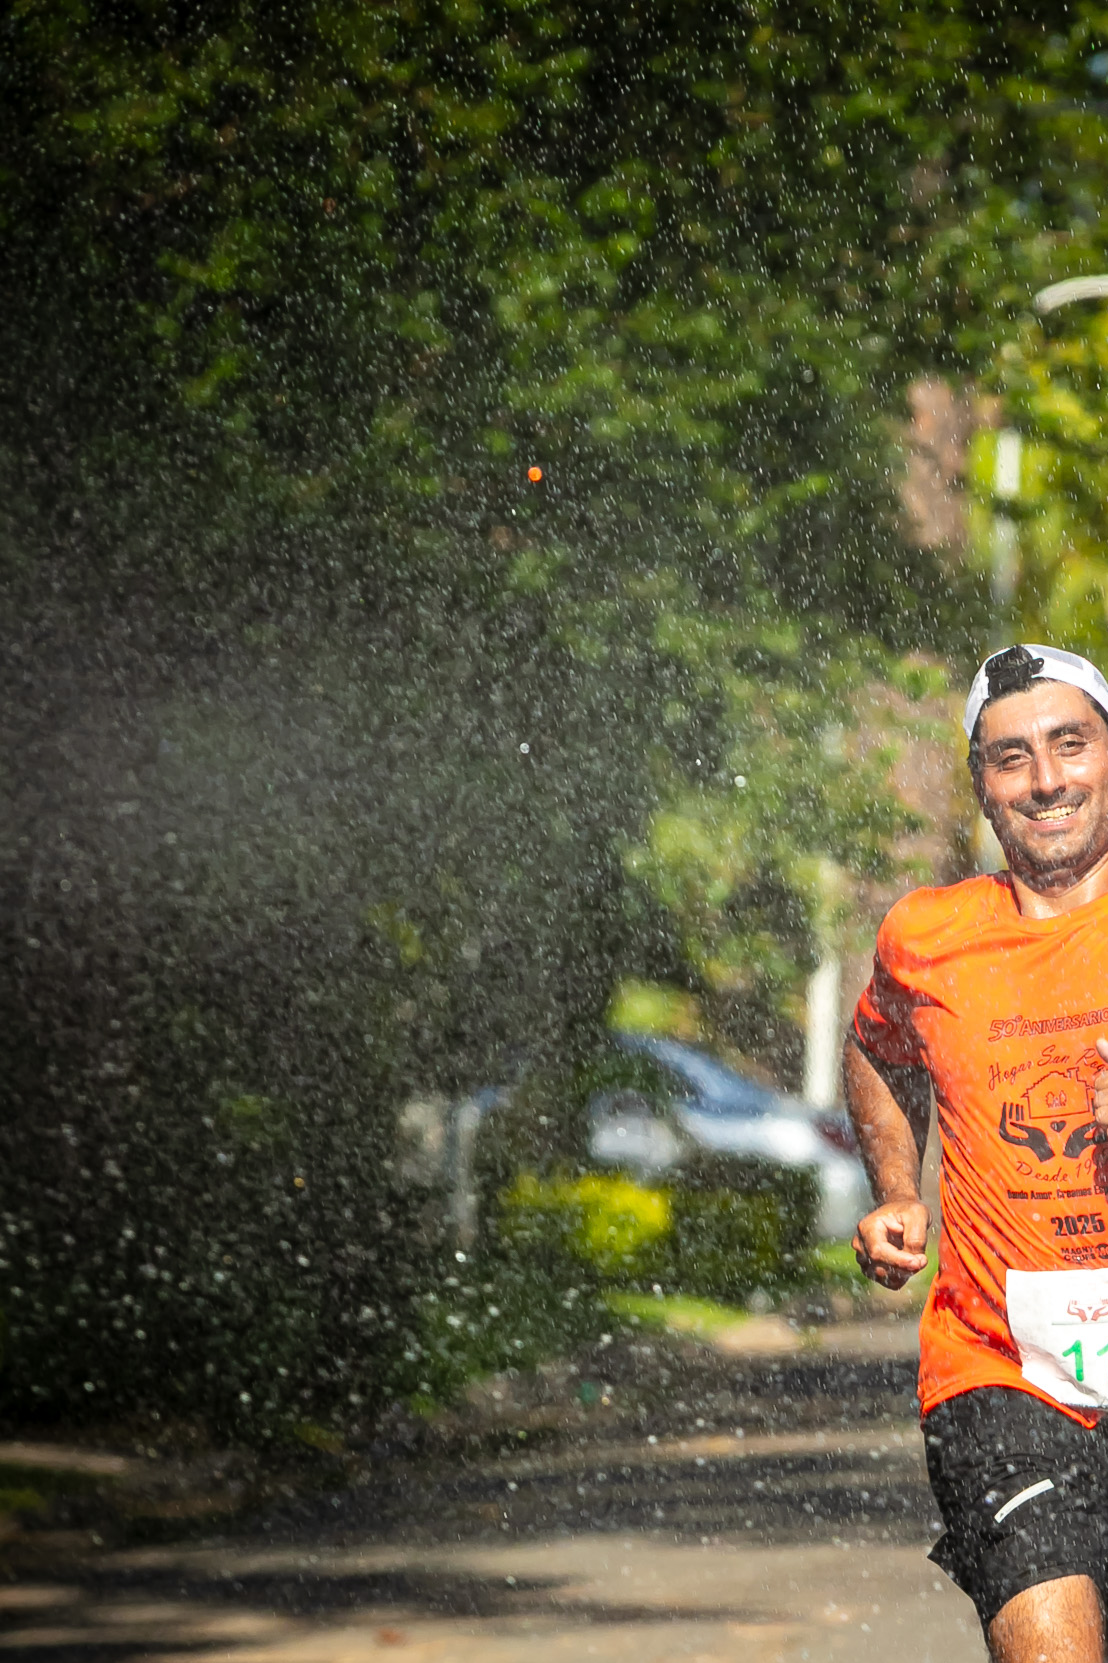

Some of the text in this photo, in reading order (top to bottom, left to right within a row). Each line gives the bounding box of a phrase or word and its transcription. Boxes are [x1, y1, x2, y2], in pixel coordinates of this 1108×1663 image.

[988, 1061, 1033, 1091] Hogar
[1037, 1044, 1070, 1067] San
[1016, 1160, 1068, 1182] Desde
[1050, 1212, 1106, 1236] 2025
[1061, 1245, 1094, 1254] MAGNY
